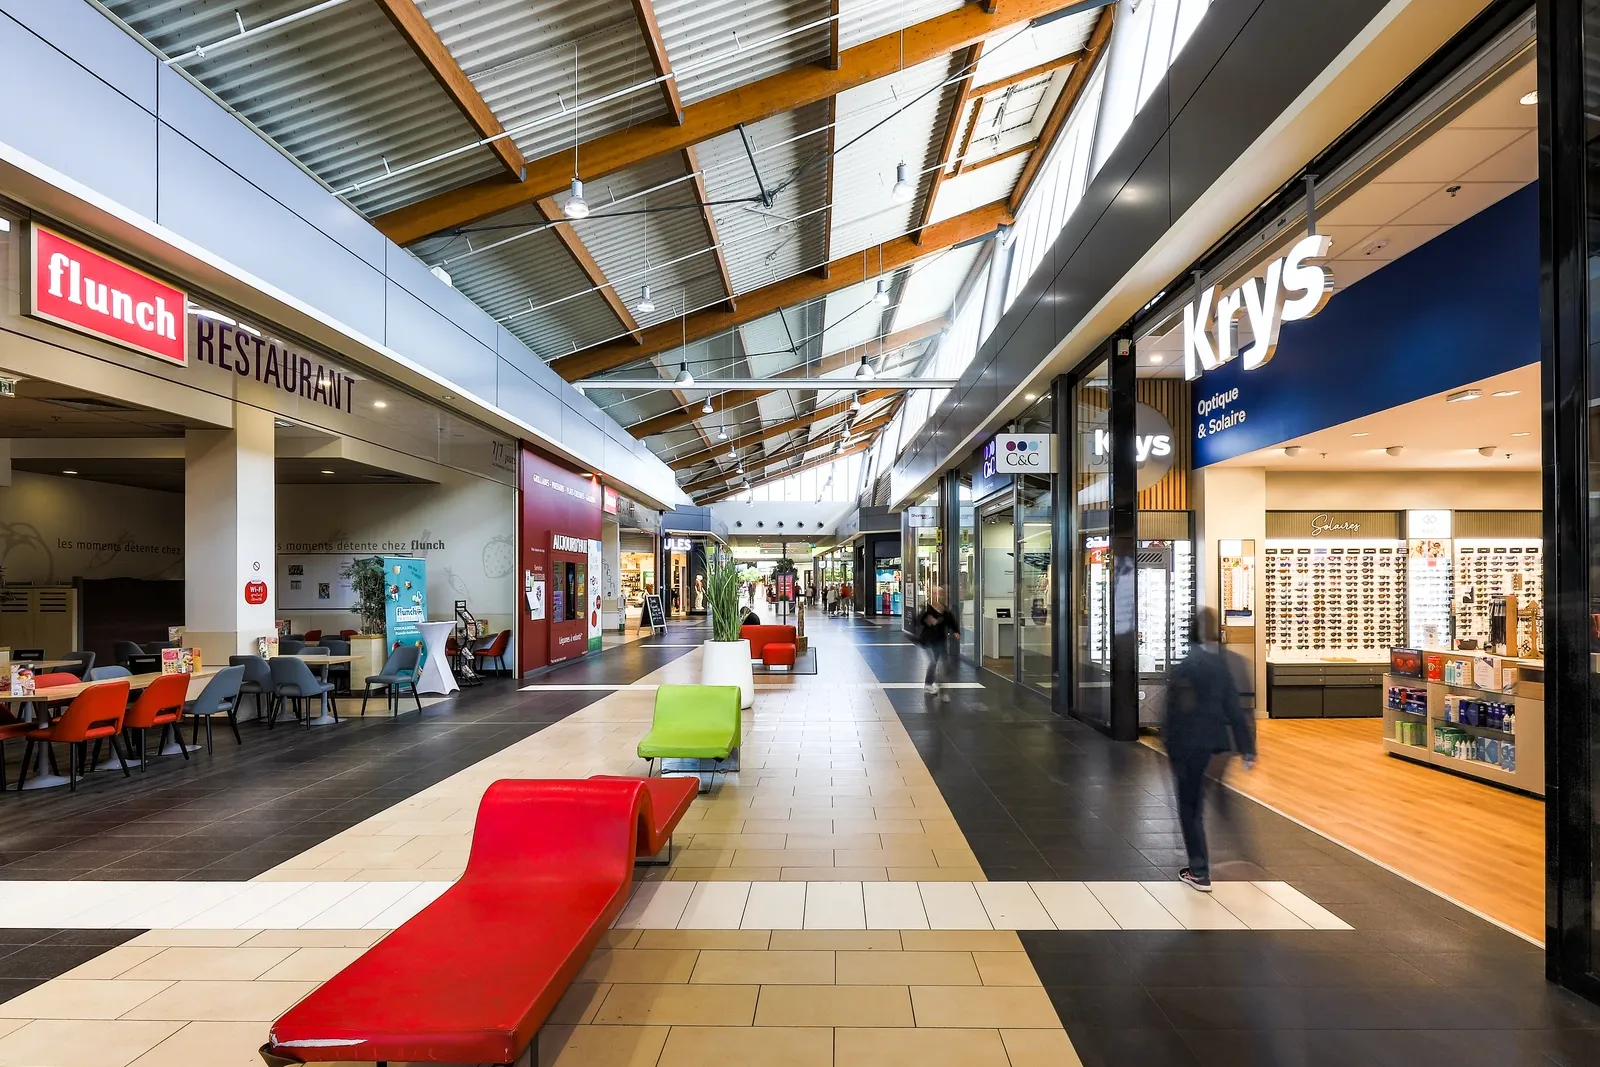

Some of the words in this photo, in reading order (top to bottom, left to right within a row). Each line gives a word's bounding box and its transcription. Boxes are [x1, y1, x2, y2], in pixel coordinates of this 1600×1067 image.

[48, 253, 176, 340] flunch
[1184, 235, 1332, 381] Krys
[197, 314, 355, 413] RESTAURANT
[1198, 388, 1239, 416] Optique
[1198, 423, 1206, 438] &
[1209, 410, 1246, 434] Solaire
[1095, 429, 1171, 462] Kys
[1006, 453, 1039, 466] C&C
[1311, 514, 1360, 536] Solaires
[57, 538, 73, 549] les
[76, 541, 122, 551] moments
[124, 542, 159, 554] détente
[161, 545, 181, 555] chez
[286, 542, 333, 550] moments
[337, 541, 378, 550] détente
[382, 541, 406, 550] chez
[411, 540, 445, 550] flunch
[664, 538, 691, 550] ULES
[250, 585, 263, 593] Wi-Fi
[397, 606, 417, 616] flunch
